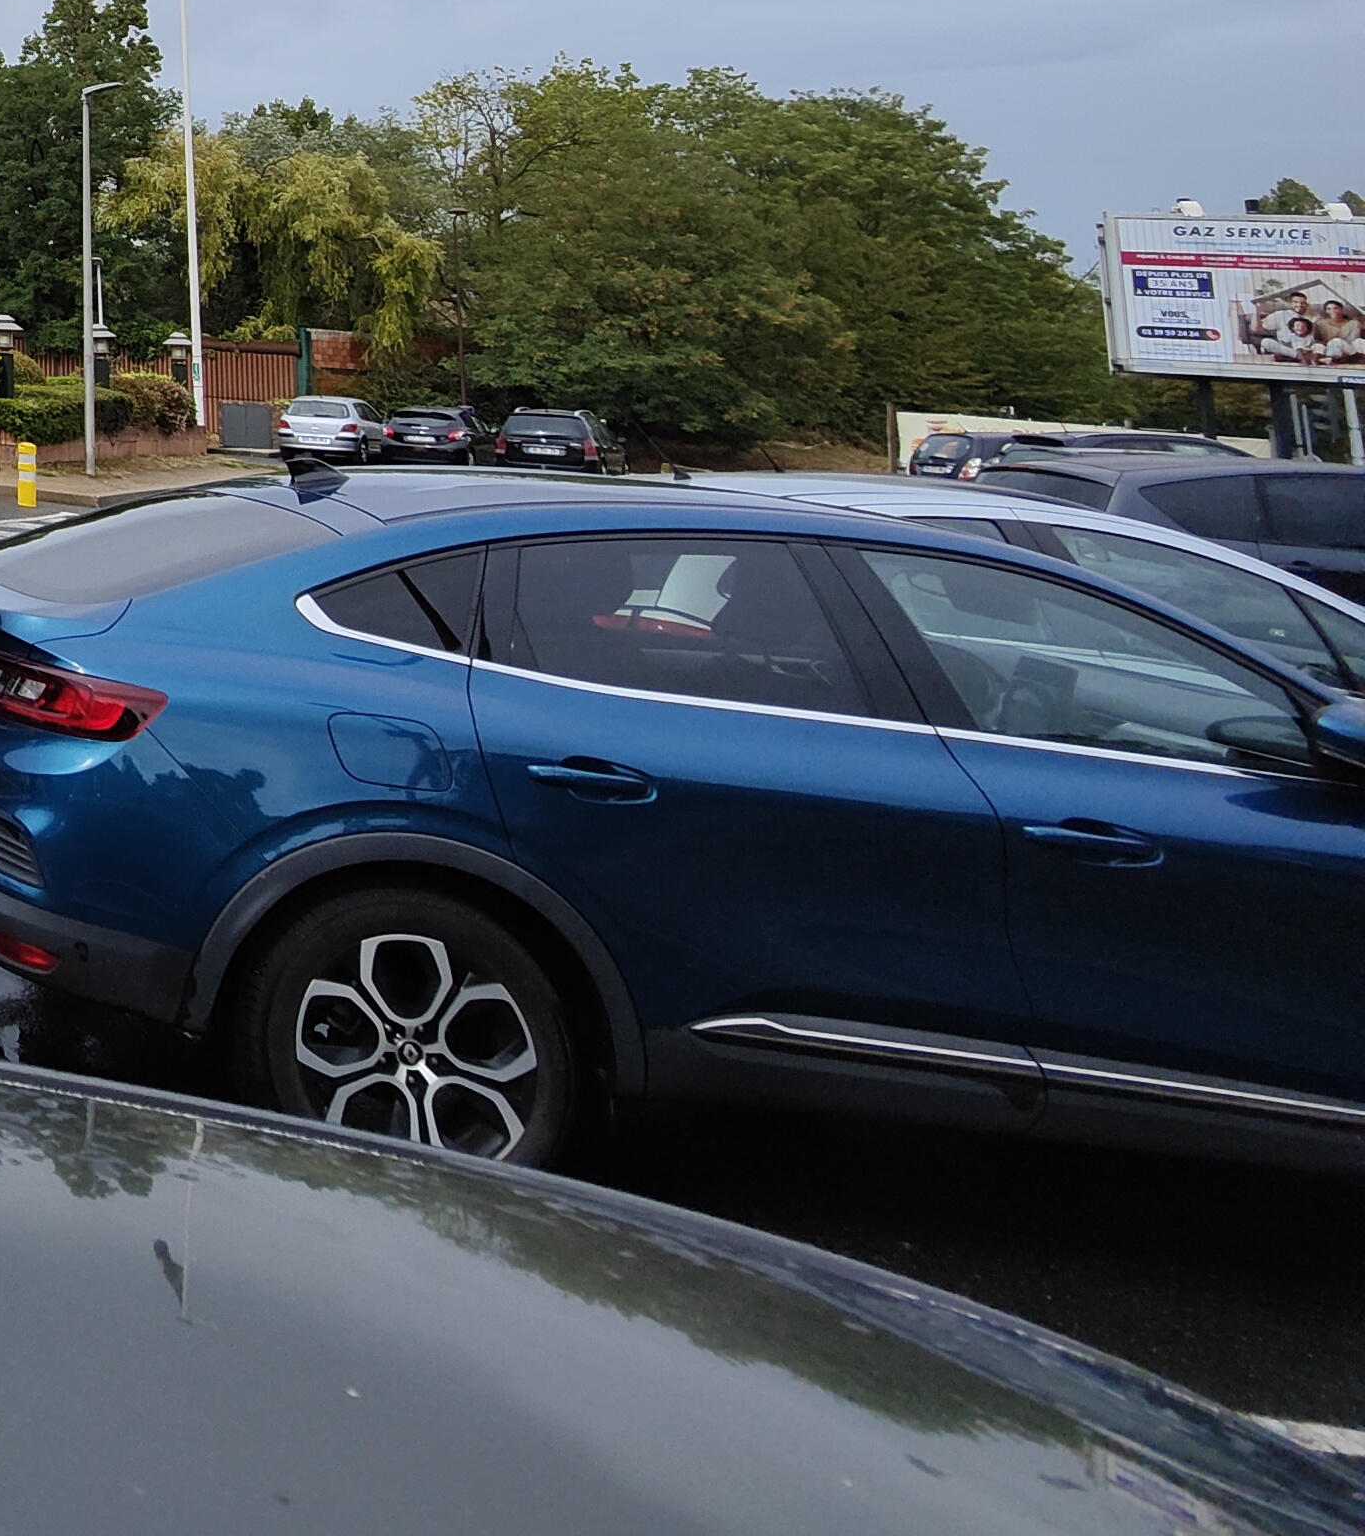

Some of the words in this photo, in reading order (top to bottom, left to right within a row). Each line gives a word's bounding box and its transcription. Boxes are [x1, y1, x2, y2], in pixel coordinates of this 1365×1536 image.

[1172, 225, 1216, 237] GAZ
[1224, 227, 1312, 240] SERVICE
[1135, 270, 1169, 278] DEPUIS
[1170, 271, 1194, 279] PLUS
[1152, 279, 1166, 287] 35
[1170, 280, 1194, 288] ANS
[1175, 290, 1212, 298] SERVICE
